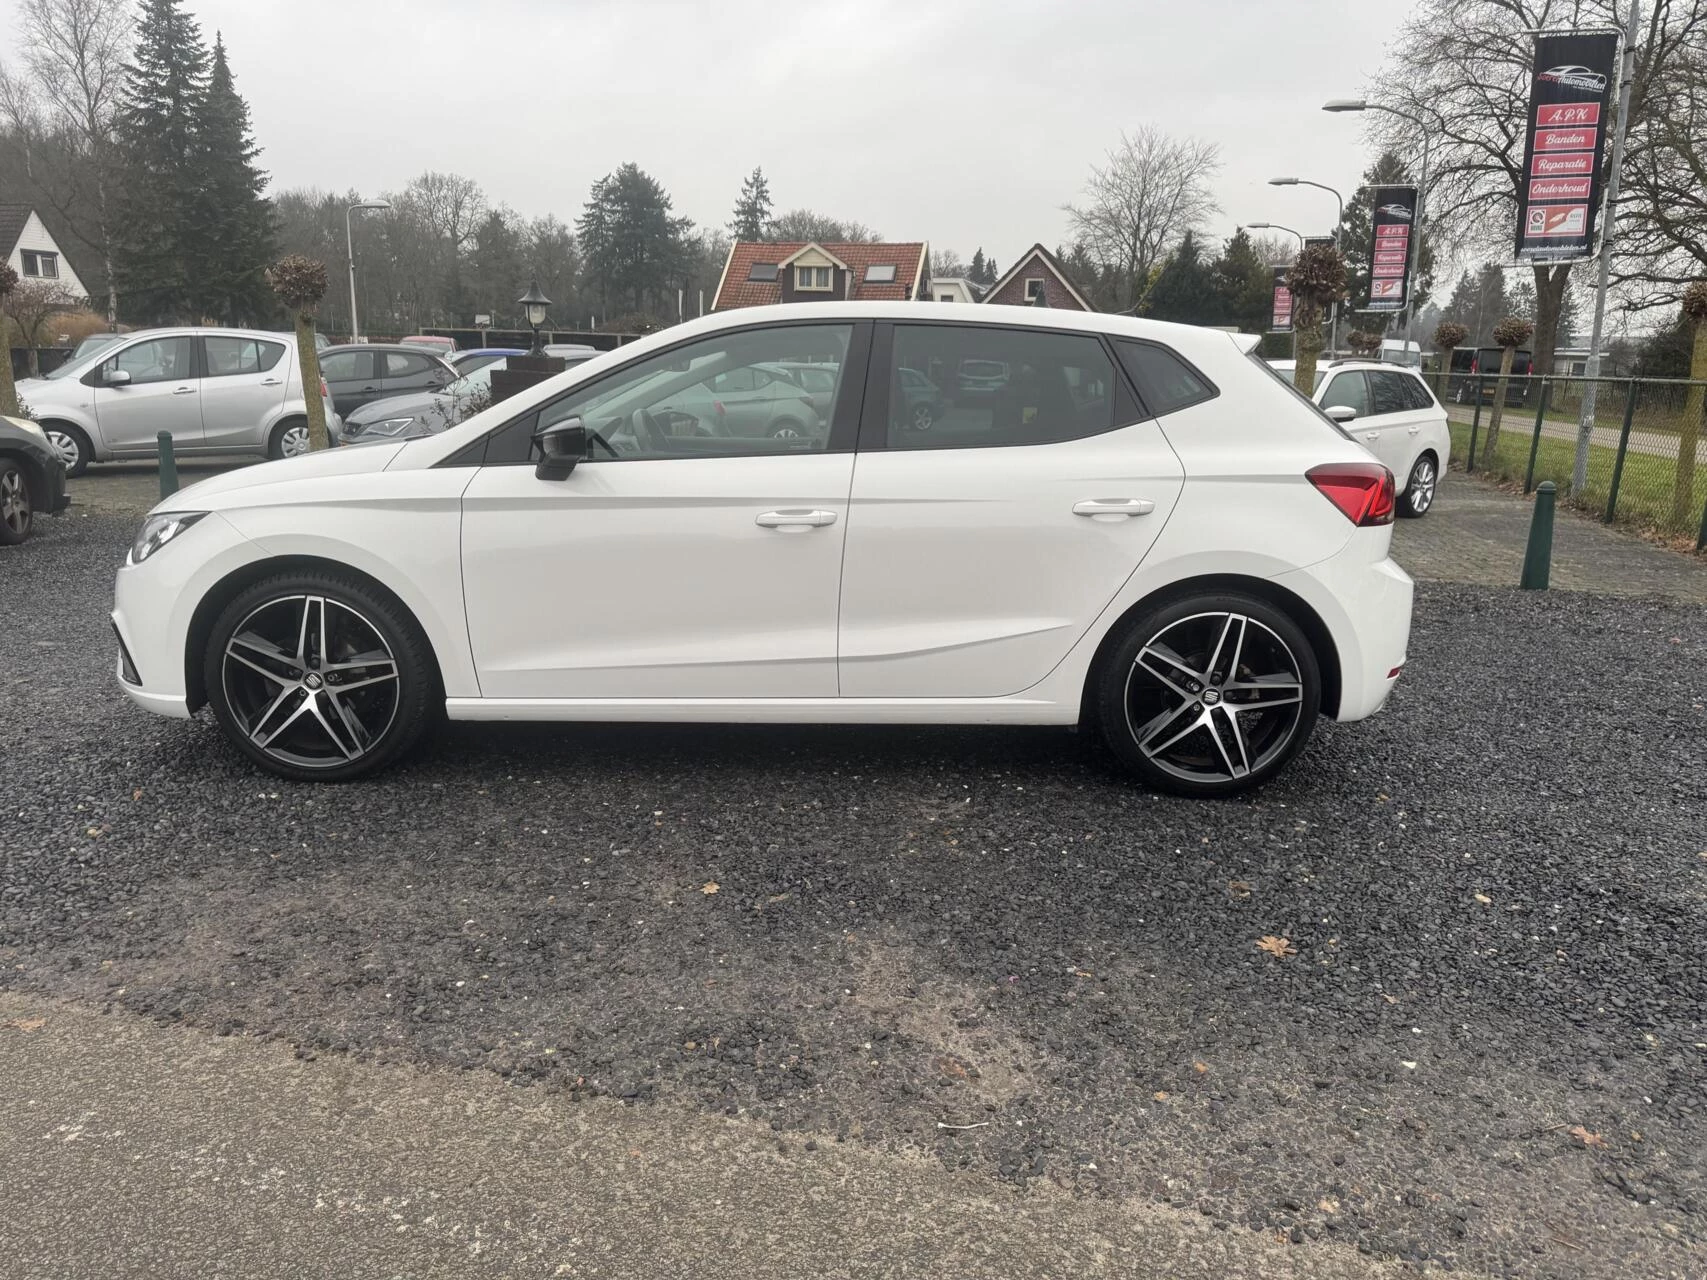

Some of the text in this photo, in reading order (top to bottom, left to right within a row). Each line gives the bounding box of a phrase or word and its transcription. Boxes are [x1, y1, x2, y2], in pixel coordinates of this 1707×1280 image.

[1545, 134, 1585, 145] Banden
[1538, 159, 1586, 172] Reparatie
[1532, 183, 1588, 194] Onderhoud
